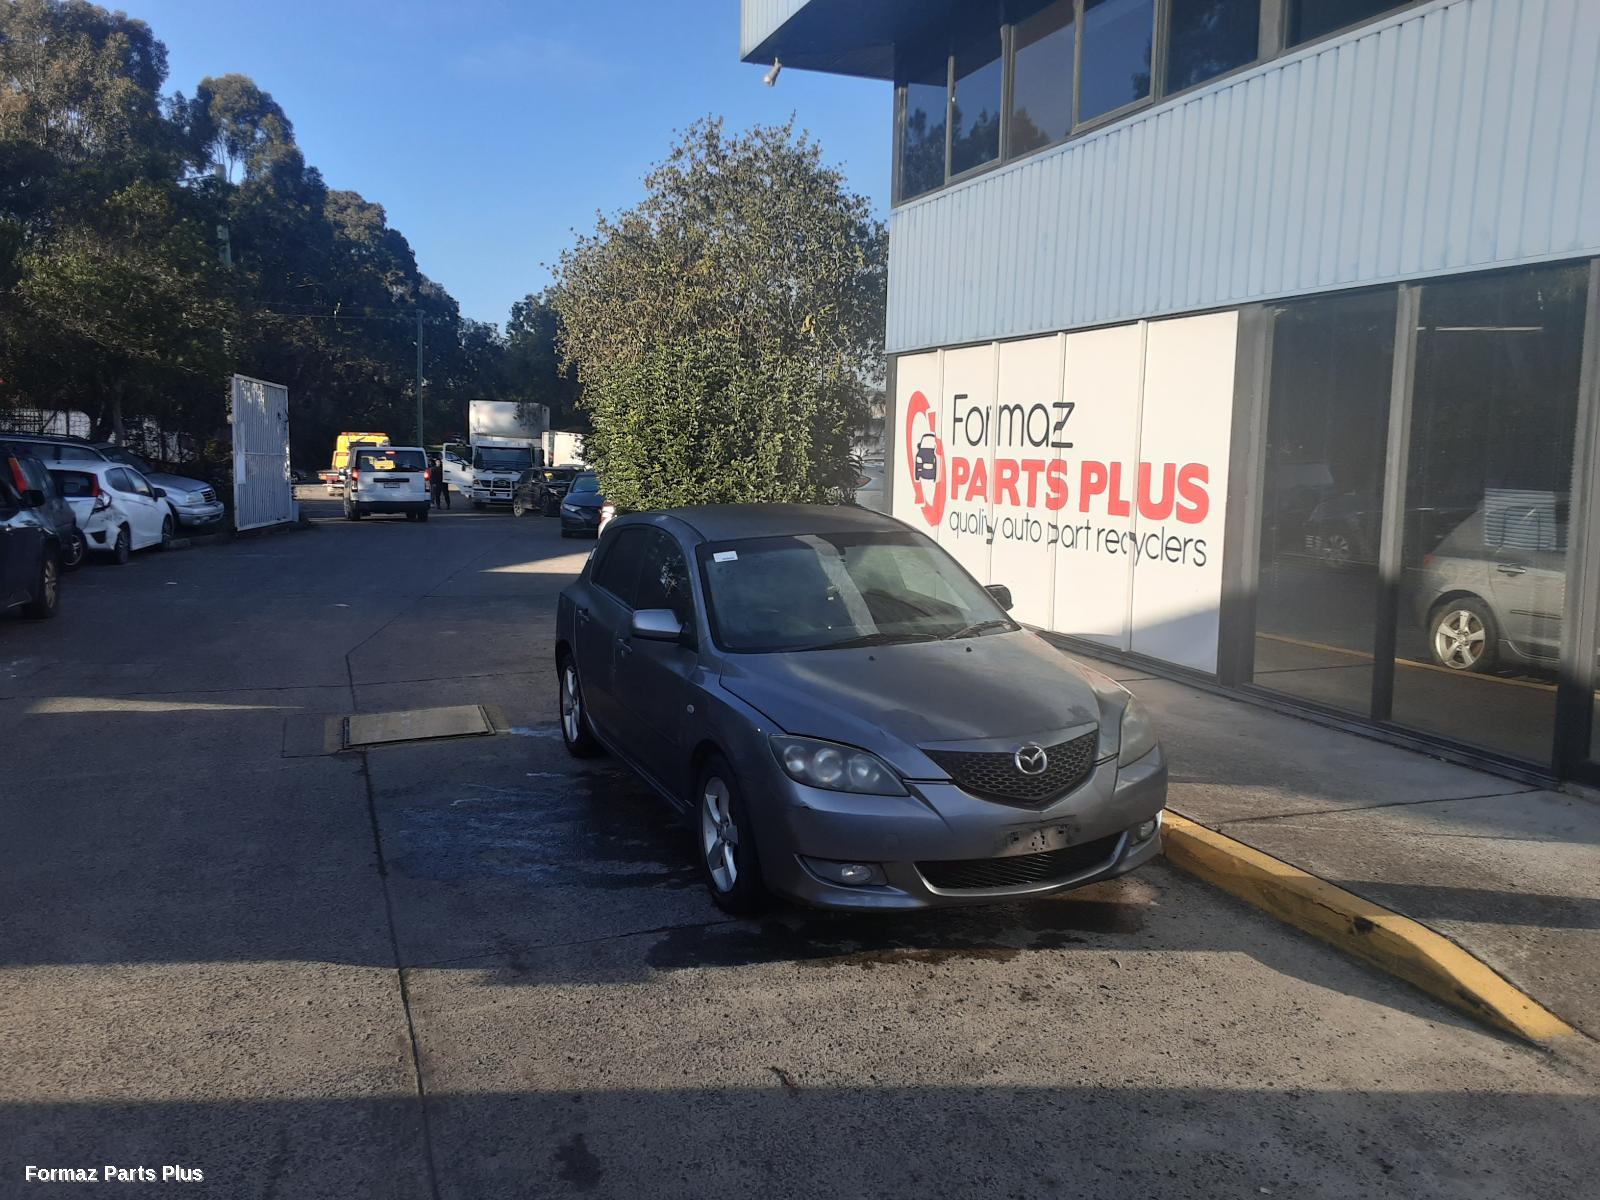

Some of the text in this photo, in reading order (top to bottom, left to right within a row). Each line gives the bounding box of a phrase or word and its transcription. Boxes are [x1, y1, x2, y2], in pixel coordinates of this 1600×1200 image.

[952, 393, 1075, 448] Formaz
[951, 456, 1210, 524] PARTS PLUS
[1002, 512, 1042, 542] auto
[1047, 519, 1091, 552] part
[1097, 526, 1207, 567] recyclers
